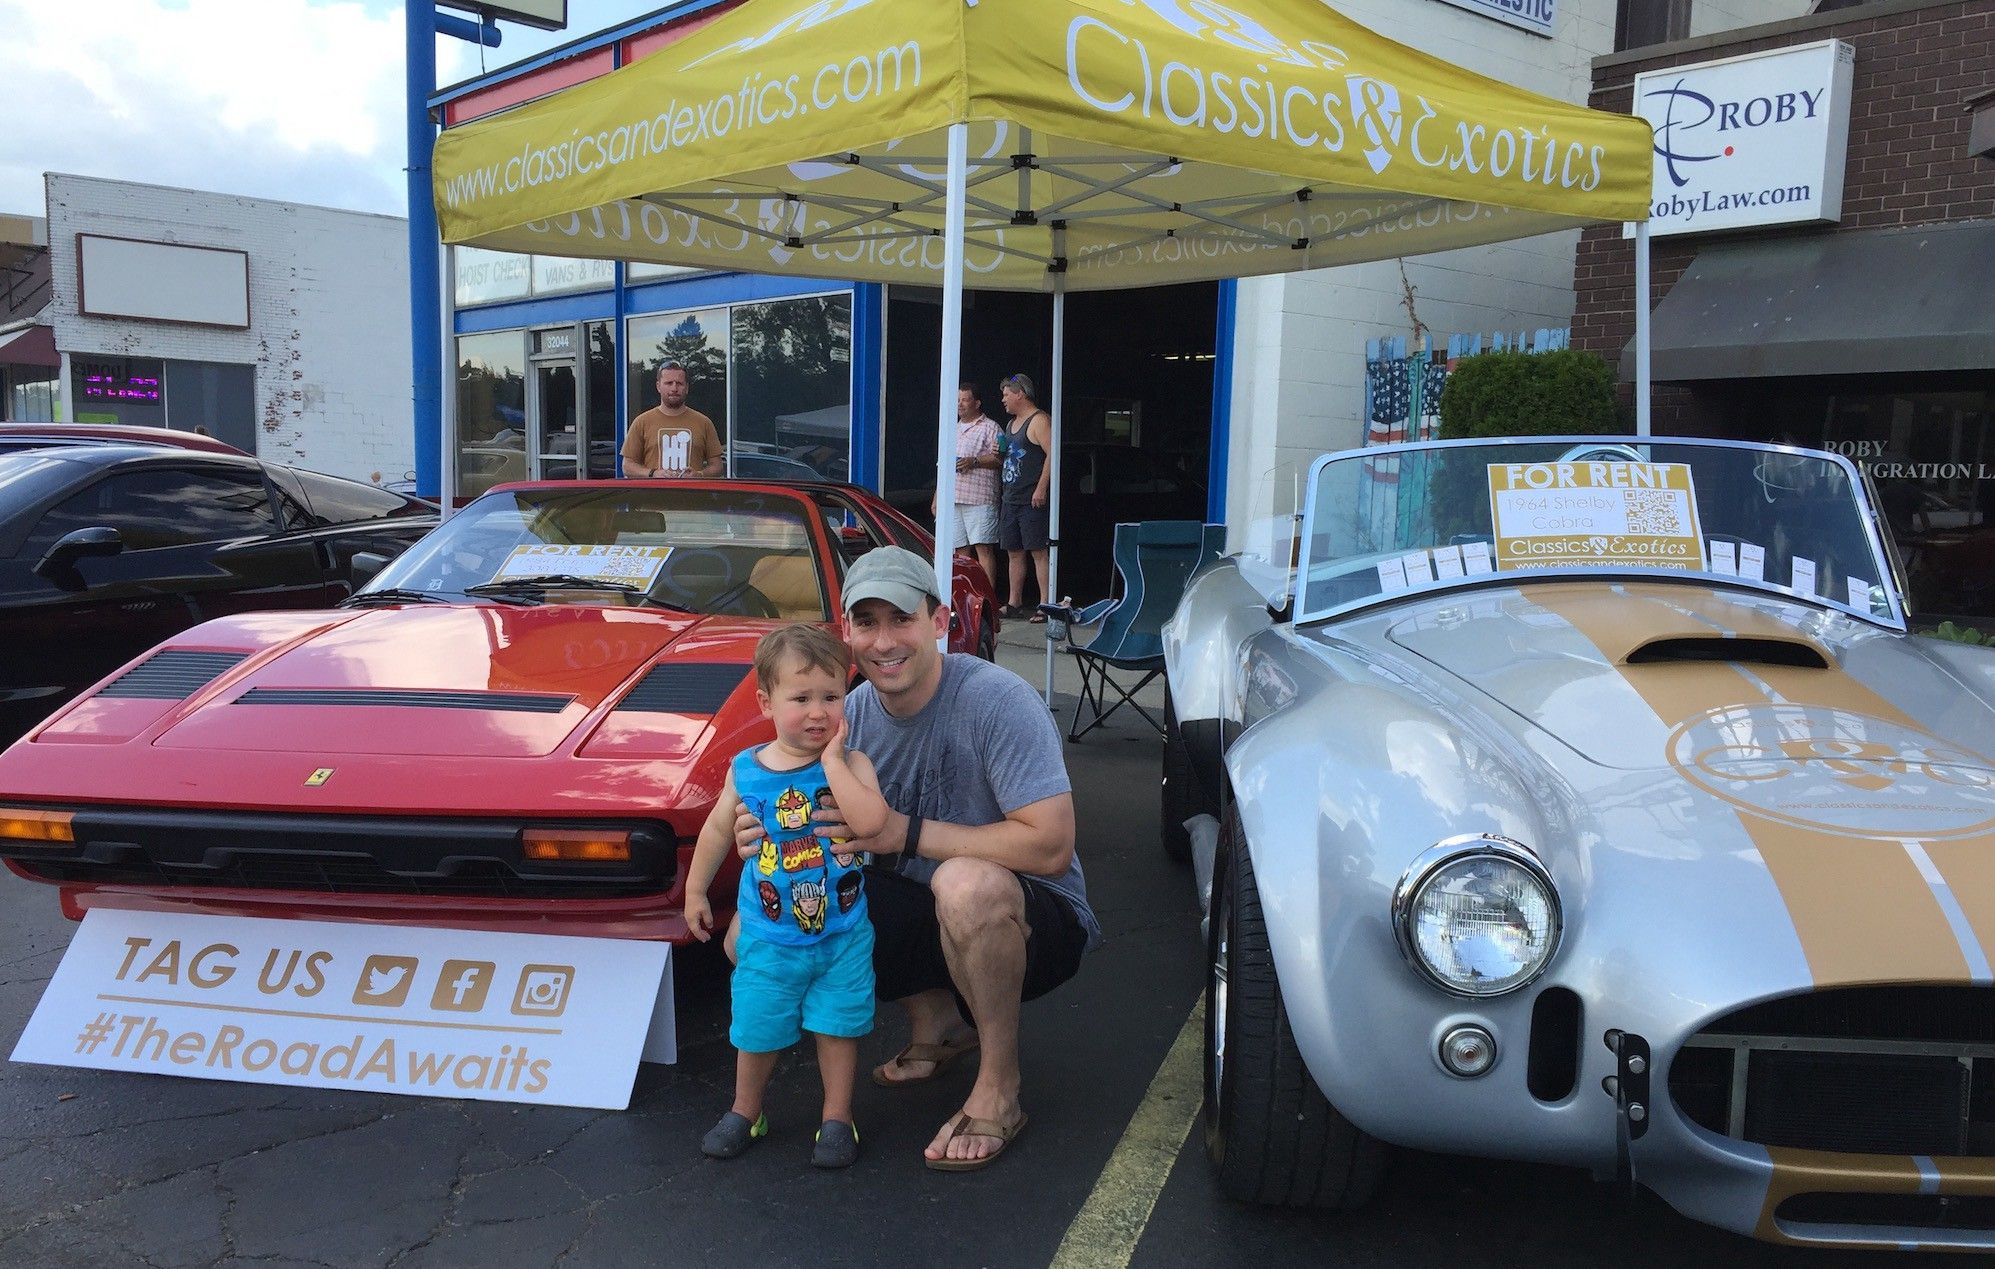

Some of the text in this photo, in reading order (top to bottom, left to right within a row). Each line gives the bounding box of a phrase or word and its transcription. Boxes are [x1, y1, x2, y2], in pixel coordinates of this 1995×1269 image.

[1066, 15, 1344, 153] Classics
[1410, 94, 1605, 192] Exotics
[445, 40, 921, 208] www.classicsandexotics.com
[459, 255, 528, 287] HOIST CHECK
[545, 264, 574, 286] VANS
[578, 261, 588, 281] &
[547, 336, 569, 349] 32044
[1823, 440, 1888, 458] ROBY
[1507, 463, 1671, 489] FOR RENT
[1820, 461, 1970, 480] IMIGRATION
[1508, 495, 1615, 513] 1964 Shelby
[1532, 516, 1594, 530] Cobra
[526, 545, 659, 558] FOR RENT
[1510, 537, 1590, 555] Classics
[1609, 537, 1687, 555] Exotics
[1515, 559, 1686, 570] wwwclassicsandexoticscom
[782, 845, 824, 870] COMICS
[114, 936, 239, 989] TAG
[257, 949, 334, 999] US
[75, 1011, 551, 1094] #TheRoadAwaits
